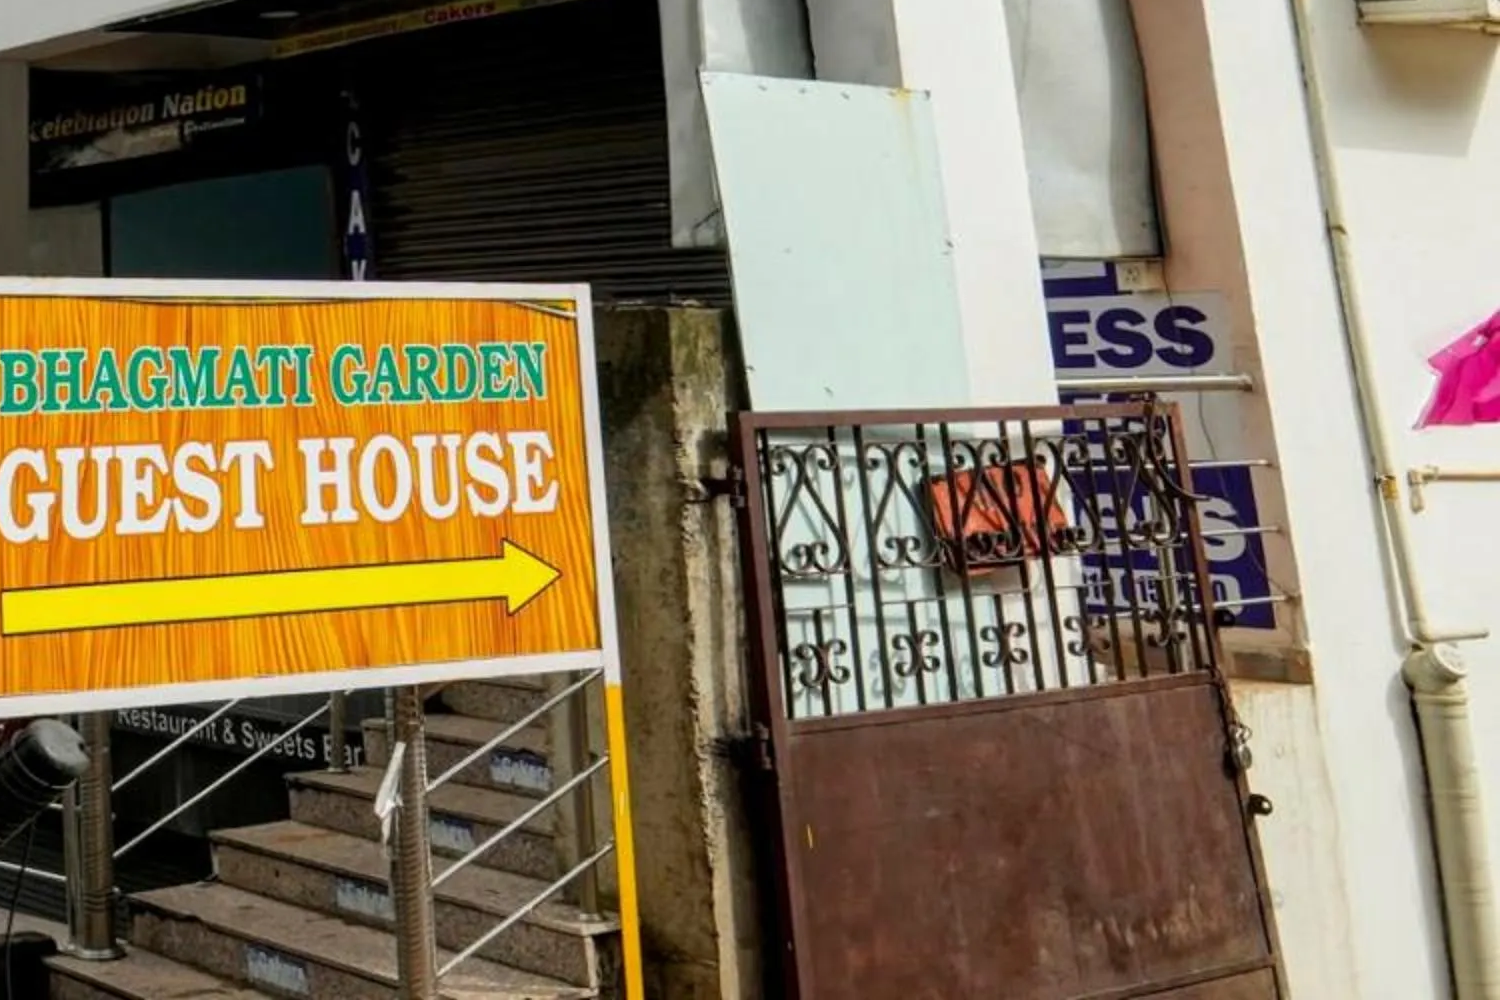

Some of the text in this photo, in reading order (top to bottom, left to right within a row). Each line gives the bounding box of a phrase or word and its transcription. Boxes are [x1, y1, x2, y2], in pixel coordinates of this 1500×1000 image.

[160, 83, 249, 120] Nation
[329, 342, 546, 403] GARDEN
[298, 430, 560, 526] HOUSE
[223, 718, 237, 744] &
[241, 722, 317, 761] Sweets
